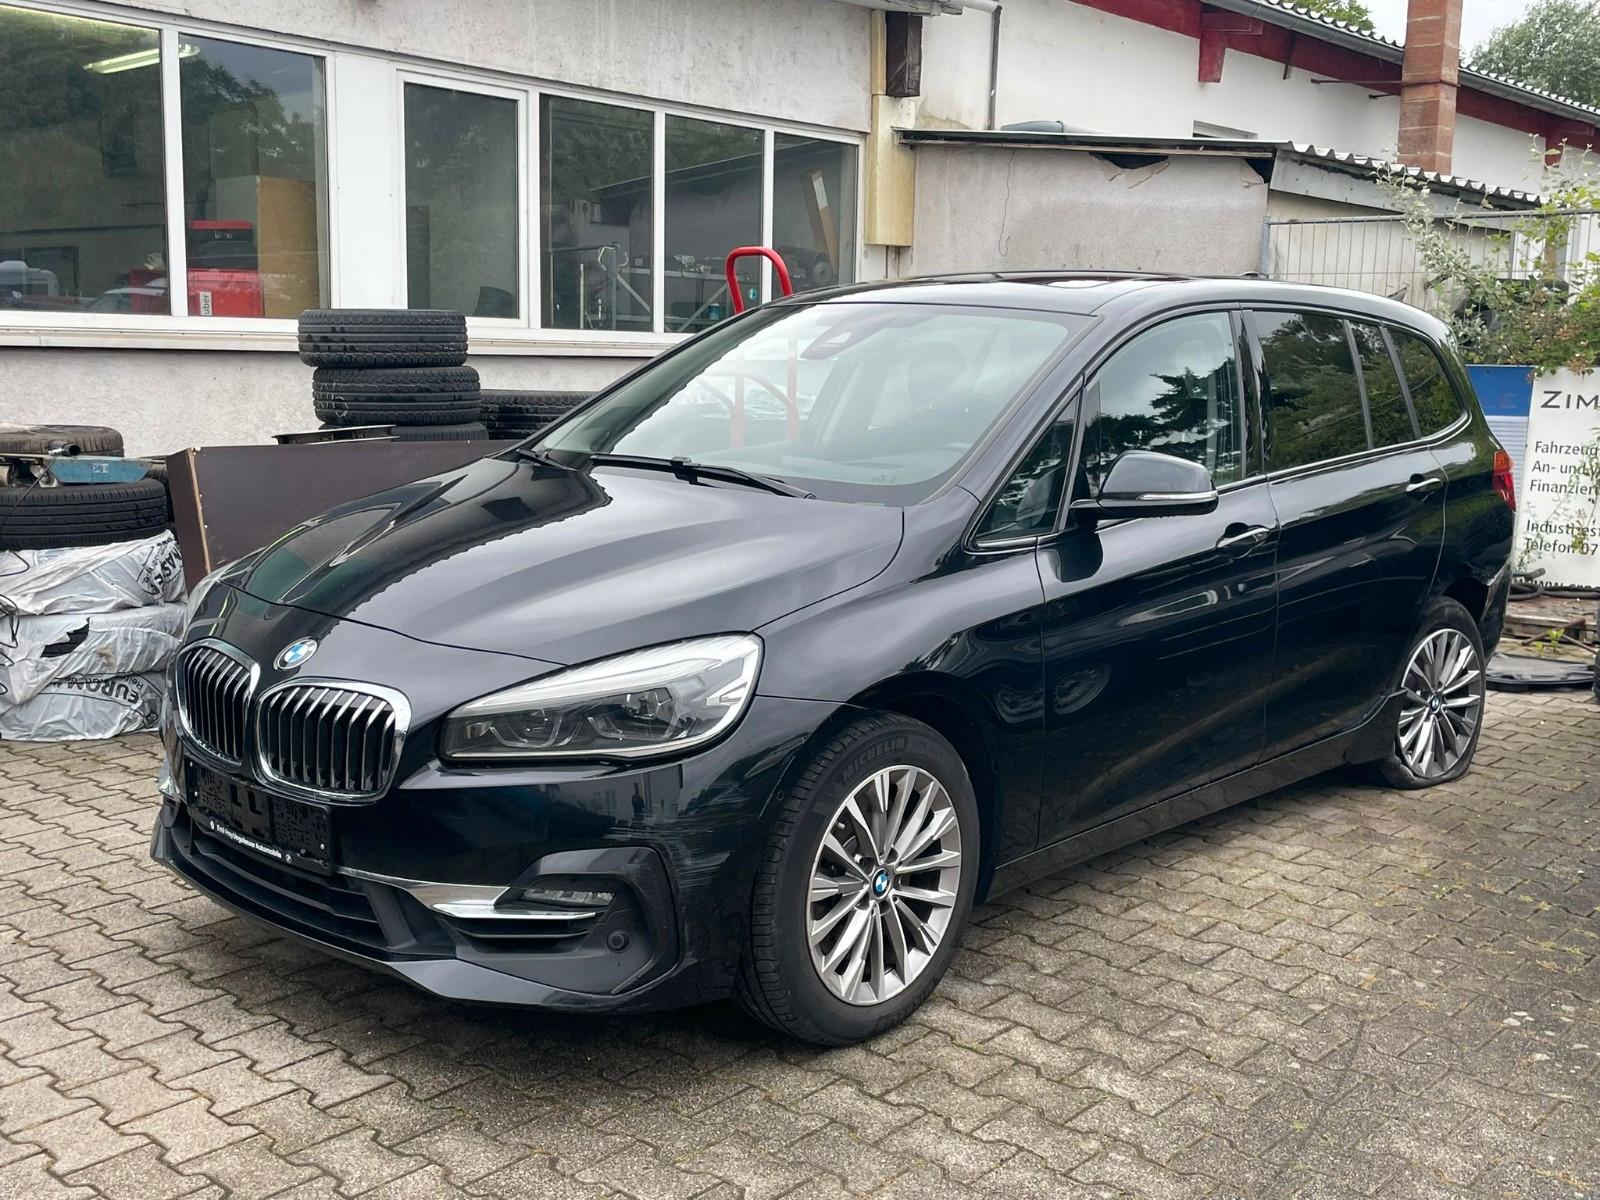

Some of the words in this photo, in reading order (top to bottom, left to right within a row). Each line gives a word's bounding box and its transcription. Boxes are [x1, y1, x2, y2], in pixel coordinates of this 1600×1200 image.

[1541, 391, 1599, 409] ZIM
[1531, 460, 1556, 473] An-
[1560, 462, 1587, 475] und
[842, 736, 905, 784] MICHELIN
